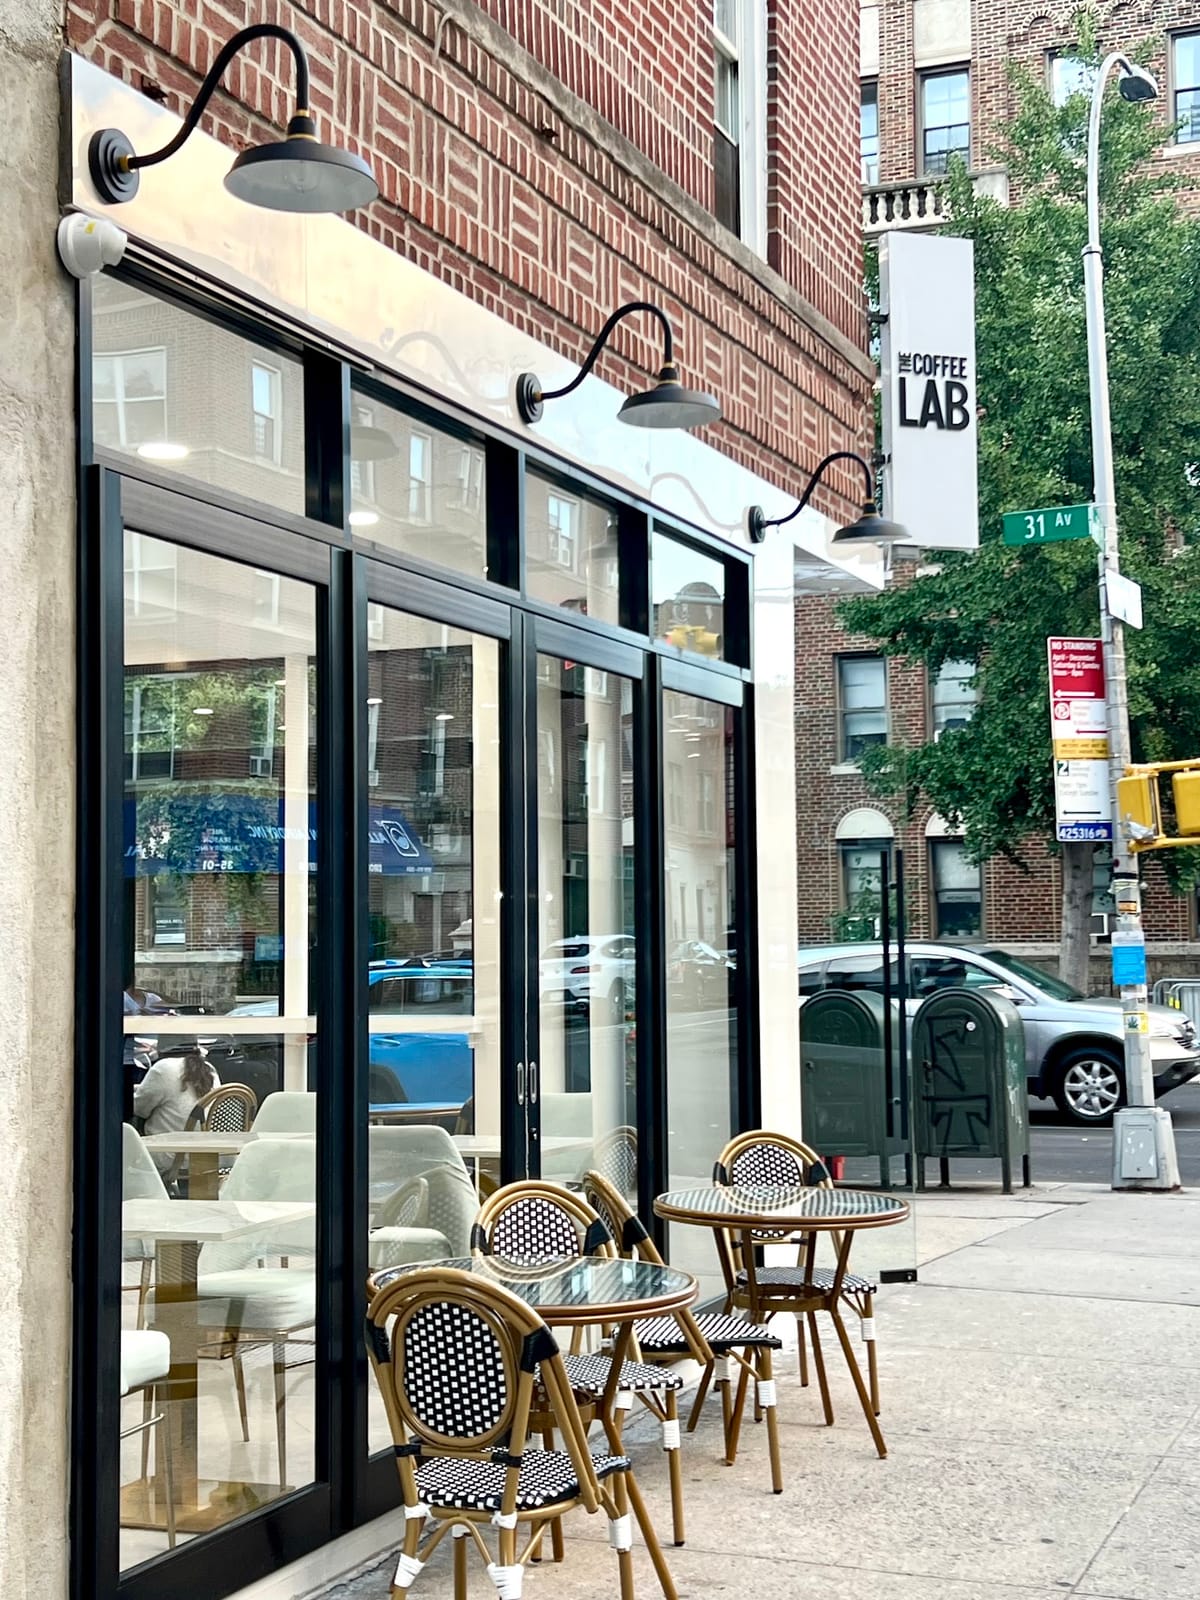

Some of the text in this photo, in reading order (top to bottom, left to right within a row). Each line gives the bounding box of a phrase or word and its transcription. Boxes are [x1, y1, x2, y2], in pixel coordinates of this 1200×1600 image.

[898, 351, 967, 379] THE COFFEE
[898, 376, 970, 431] LAB
[1024, 514, 1045, 539] 31
[1051, 641, 1097, 651] NO STANDING
[1060, 827, 1094, 839] 425316
